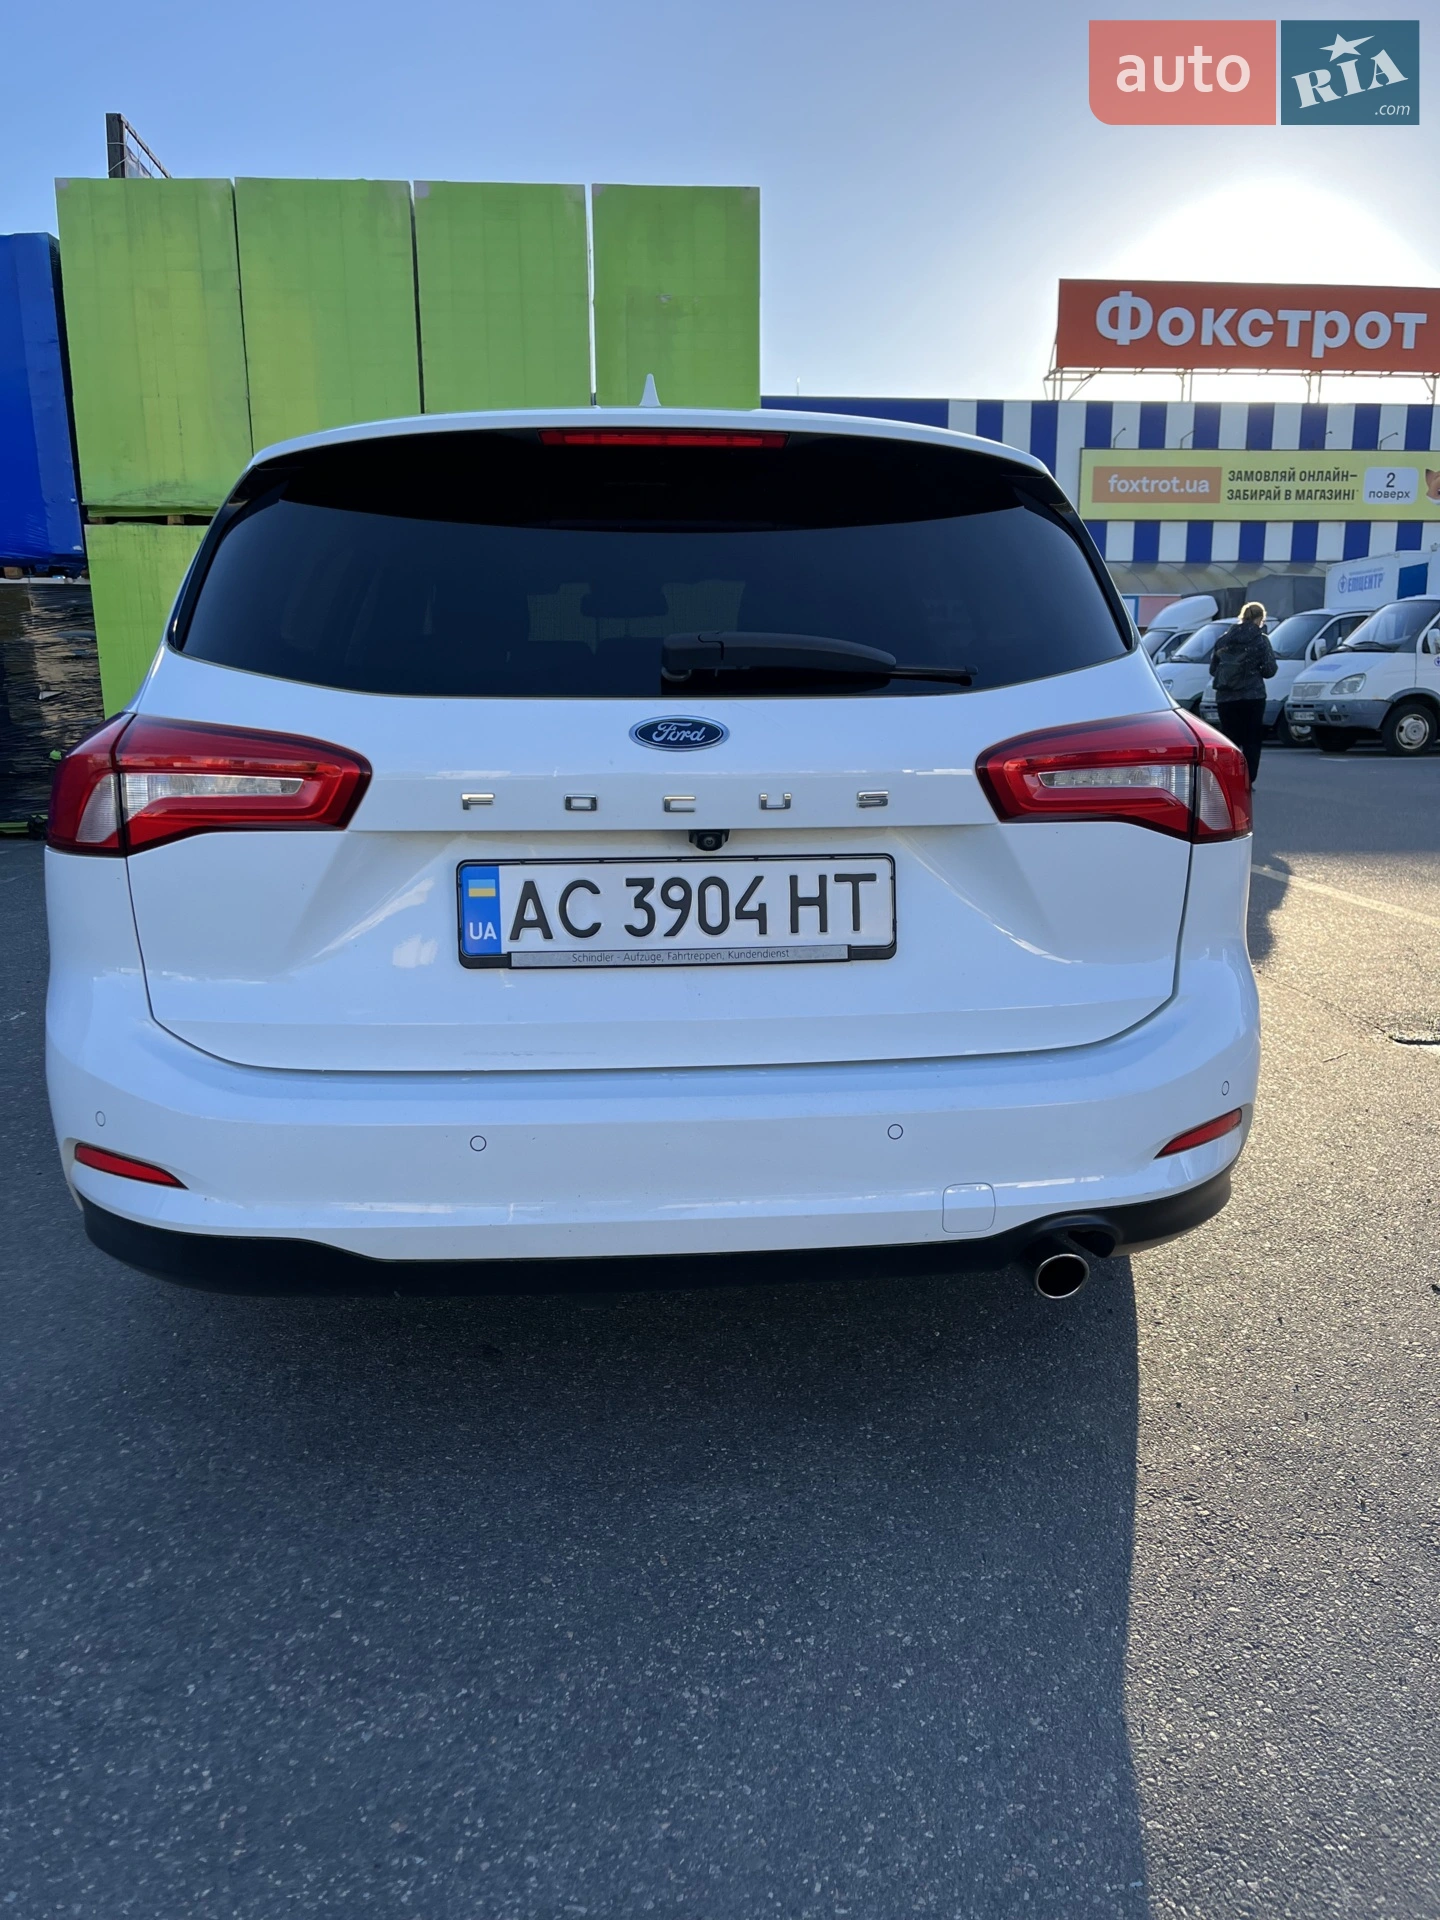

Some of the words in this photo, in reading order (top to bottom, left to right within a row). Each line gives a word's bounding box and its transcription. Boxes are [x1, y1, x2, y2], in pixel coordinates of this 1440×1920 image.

[1095, 291, 1428, 358] Фокстрот
[1108, 474, 1210, 493] foxtrot.ua
[1228, 467, 1296, 482] ЗАМОВЛЯЙ
[1385, 472, 1396, 488] 2
[1226, 486, 1281, 501] ЗАБИРАЙ
[1285, 489, 1291, 501] В
[1368, 489, 1411, 499] поверх
[651, 721, 706, 743] Ford
[461, 790, 889, 813] FOCUS
[508, 879, 602, 941] AC
[624, 876, 768, 938] 3904
[789, 873, 877, 934] HT
[469, 922, 498, 940] UA
[572, 952, 614, 963] Schindler
[667, 951, 725, 963] Fahrtreppen,
[728, 949, 790, 960] Kundendienst
